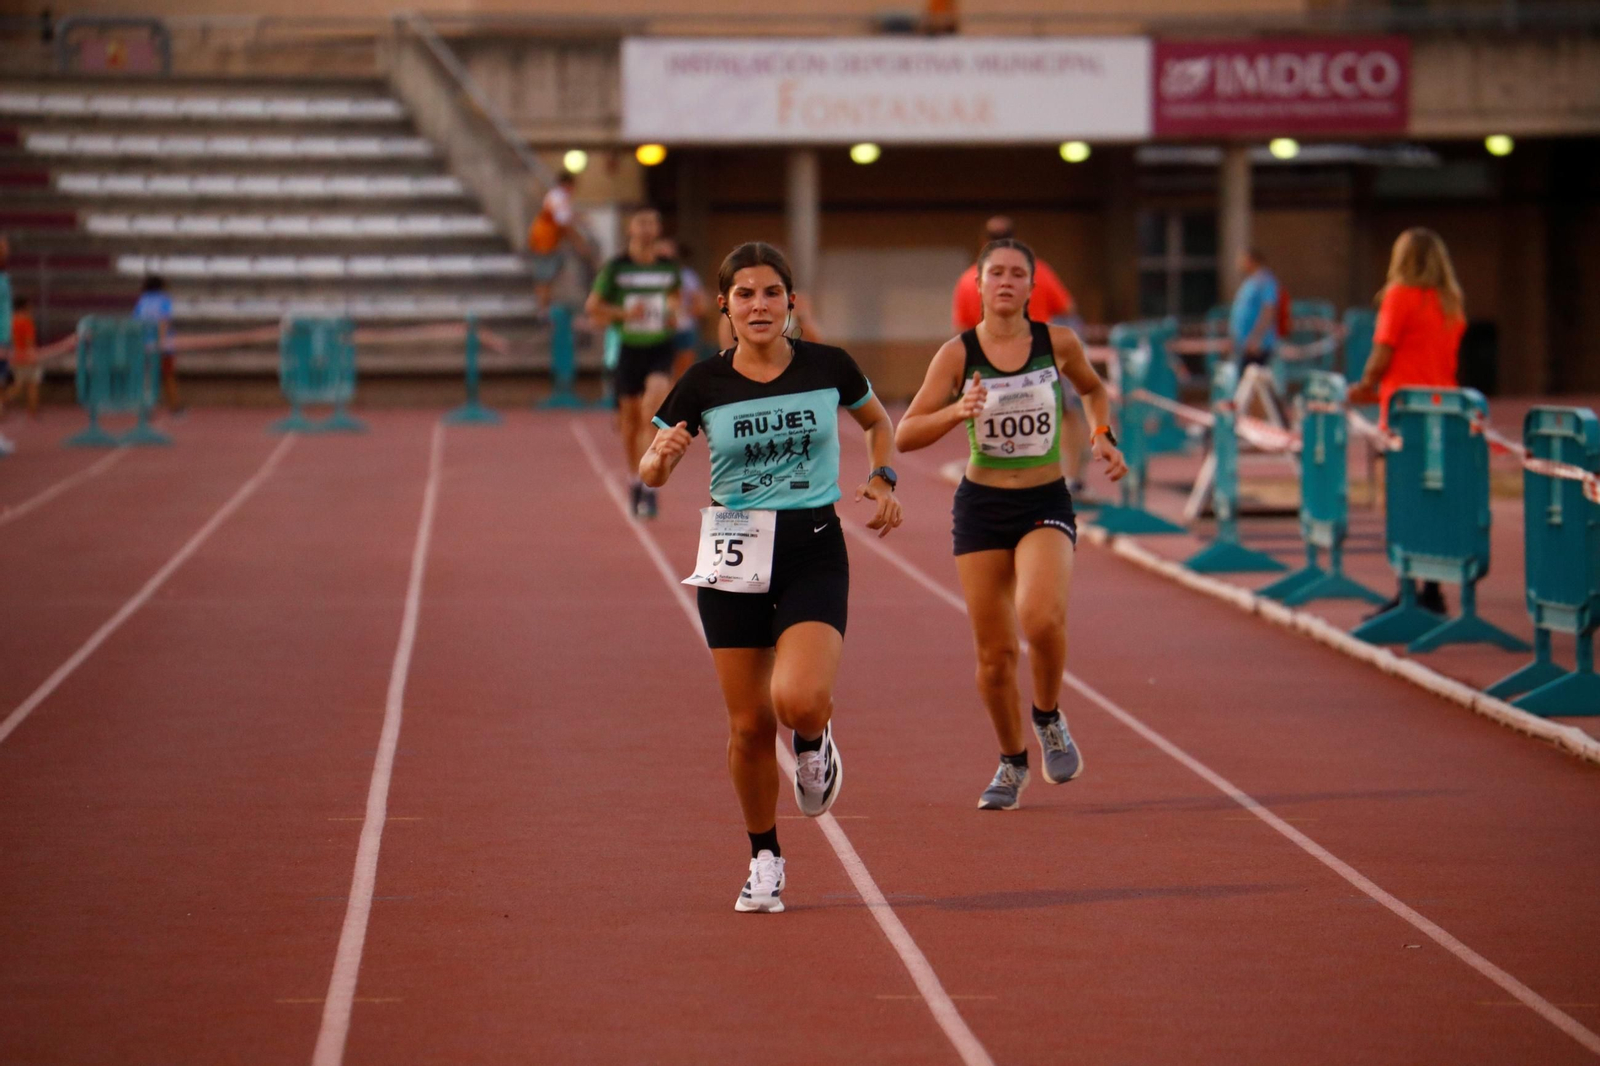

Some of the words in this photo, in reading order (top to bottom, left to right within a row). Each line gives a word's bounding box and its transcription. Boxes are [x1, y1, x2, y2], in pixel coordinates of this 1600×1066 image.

[1213, 52, 1401, 99] IMDECO
[734, 410, 816, 438] MUJER
[983, 412, 1051, 438] 1008
[712, 539, 744, 566] 55
